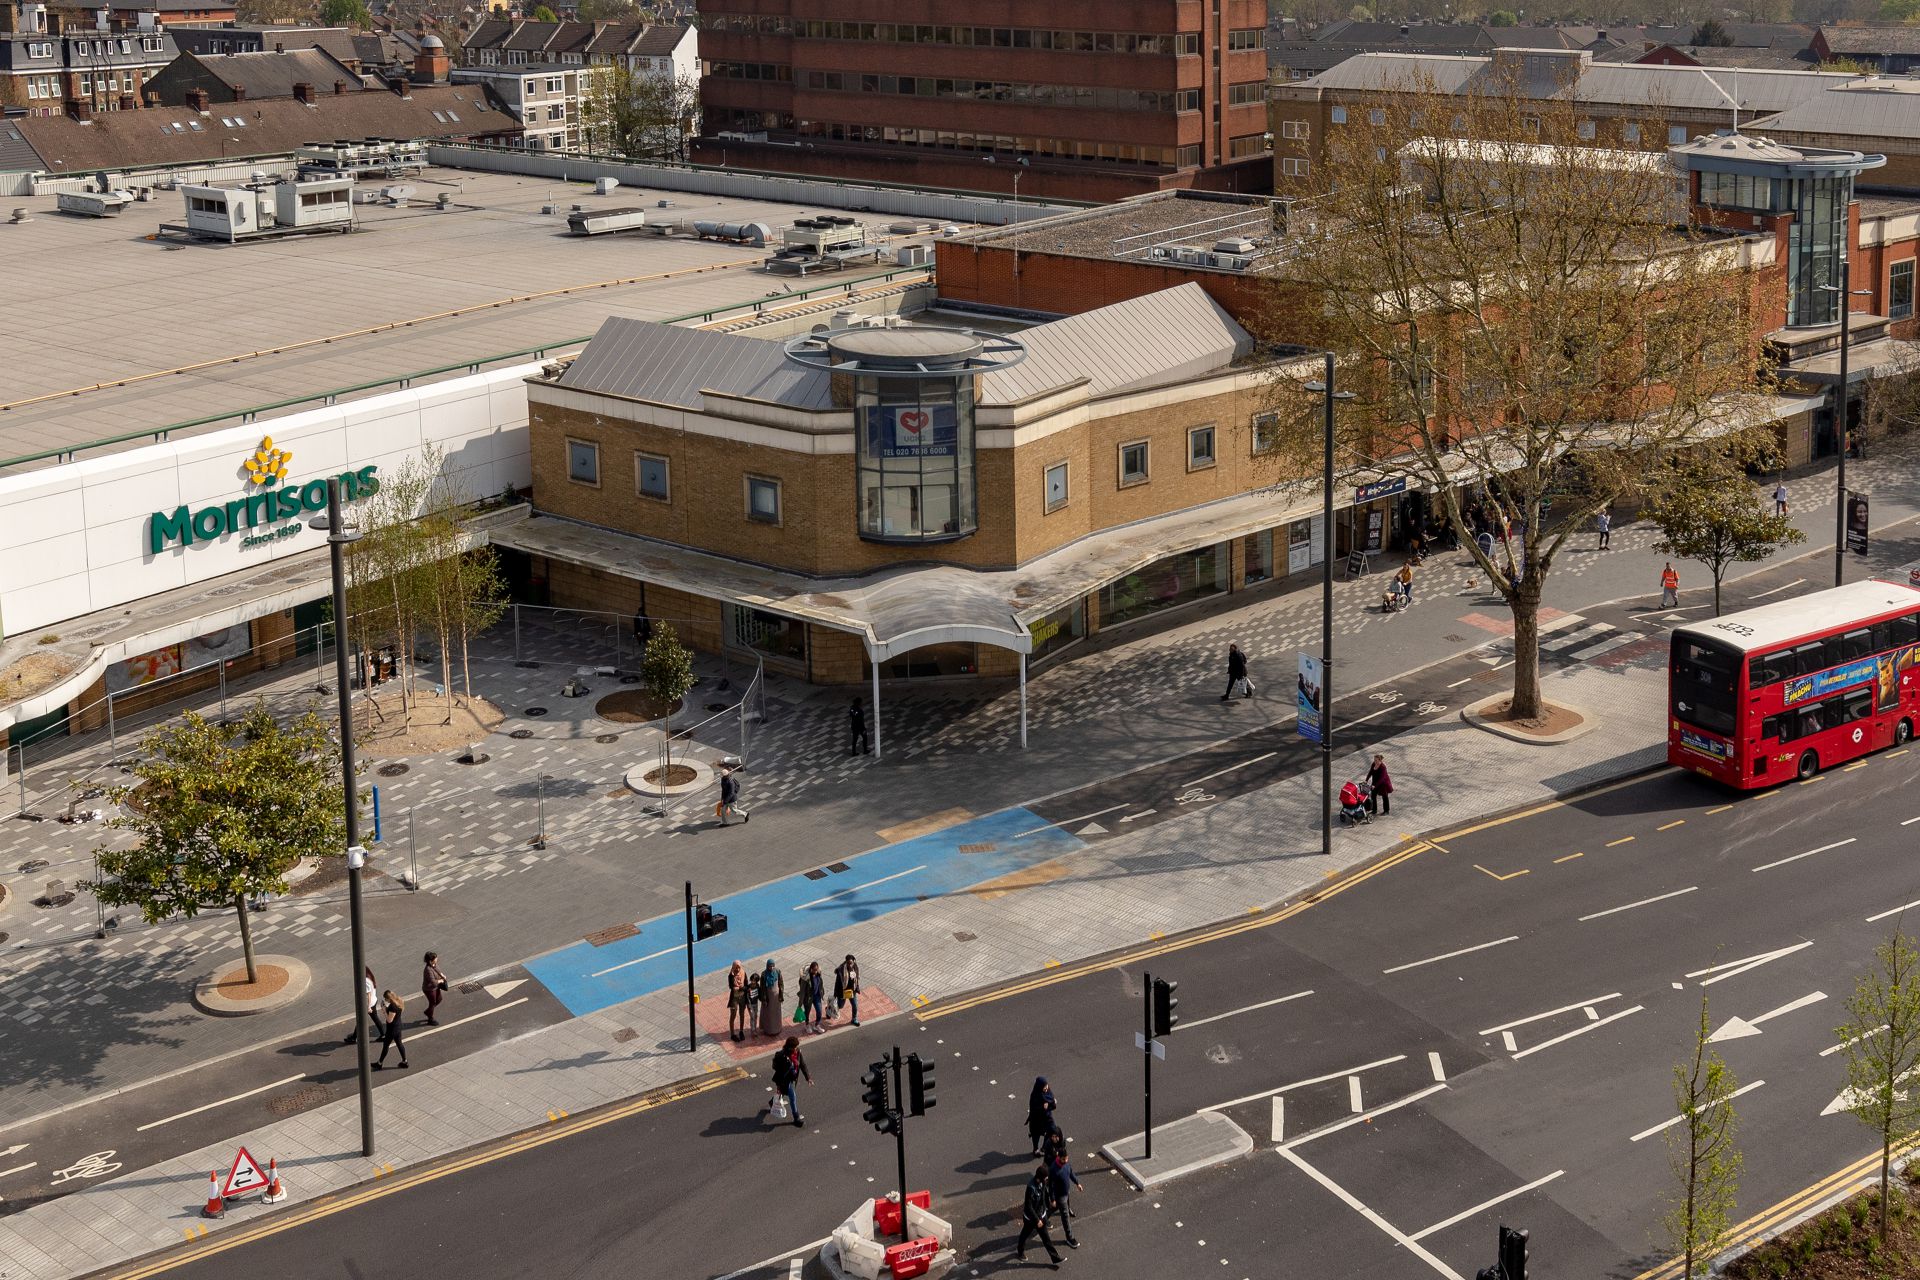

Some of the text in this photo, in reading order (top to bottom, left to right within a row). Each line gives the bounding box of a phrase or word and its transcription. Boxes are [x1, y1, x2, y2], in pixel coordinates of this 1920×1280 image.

[883, 448, 894, 456] TEL
[896, 448, 909, 456] 020
[930, 447, 947, 455] 6000
[151, 465, 380, 554] Morrisons
[243, 522, 303, 548] Since 1899
